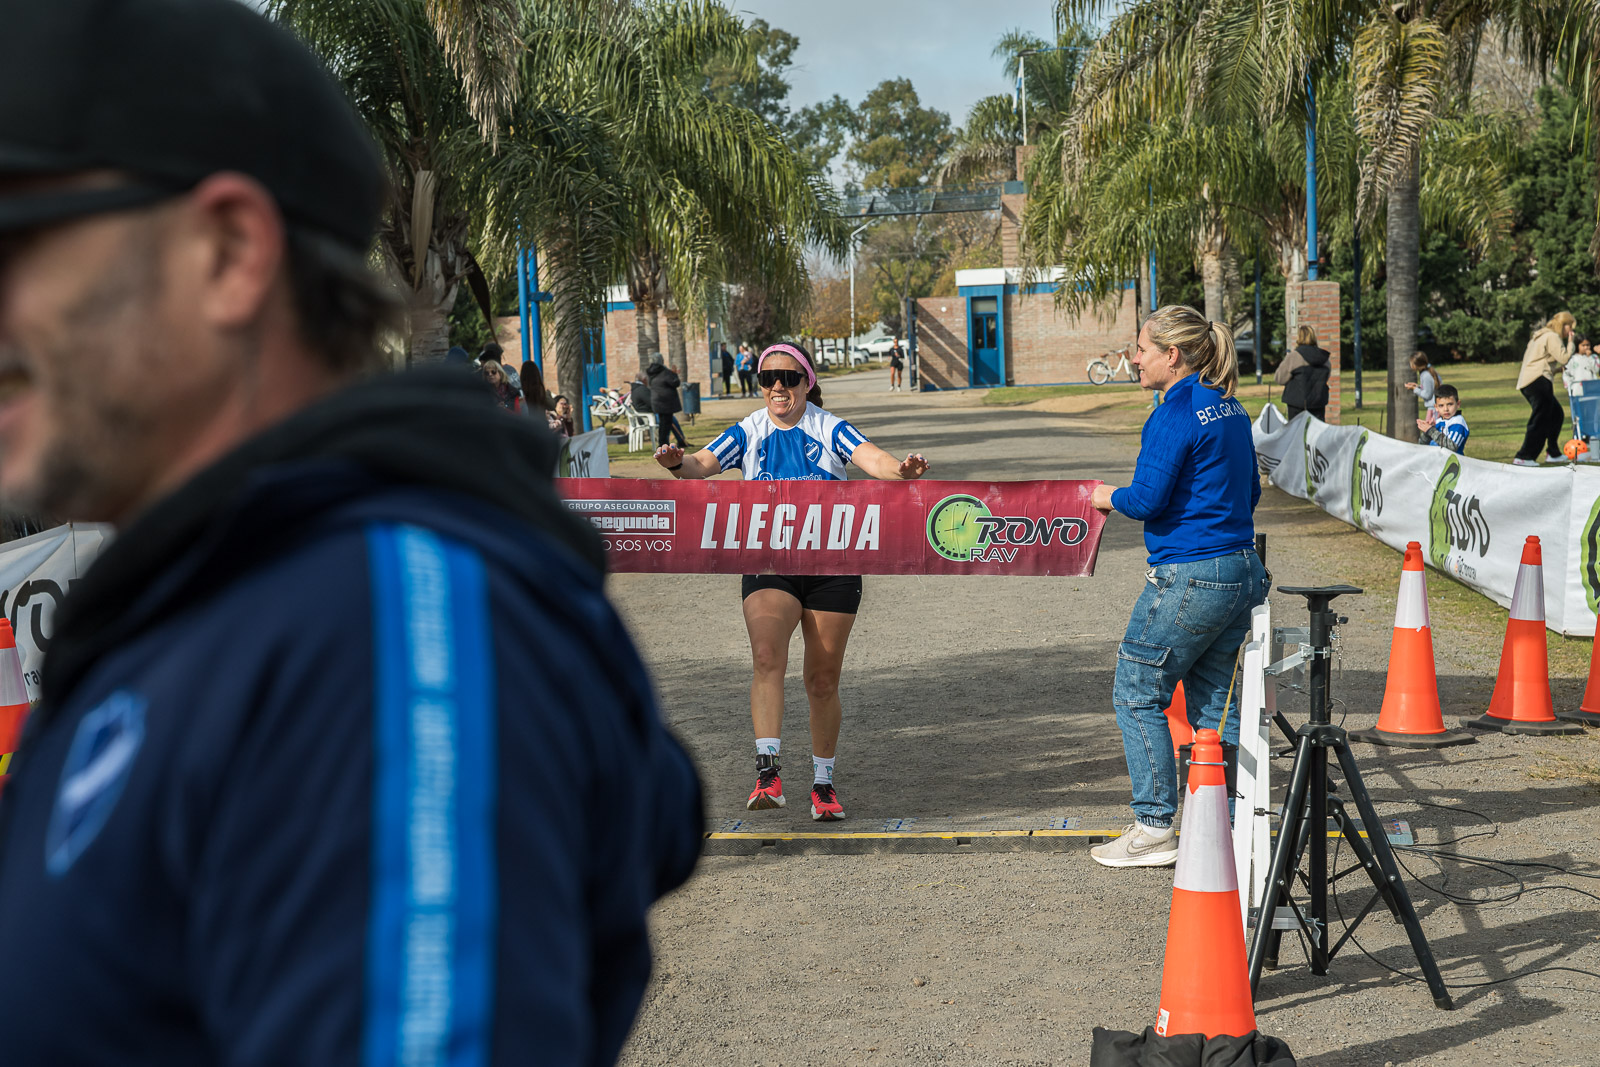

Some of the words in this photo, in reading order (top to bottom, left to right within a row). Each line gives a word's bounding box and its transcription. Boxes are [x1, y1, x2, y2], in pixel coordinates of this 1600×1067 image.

[1196, 402, 1248, 426] BELGRAN
[603, 503, 670, 511] ASEGURADOR
[590, 514, 670, 532] segunda
[700, 502, 881, 551] LLEGADA
[616, 539, 642, 552] SOS
[644, 539, 672, 552] VOS
[969, 547, 1019, 563] RAV
